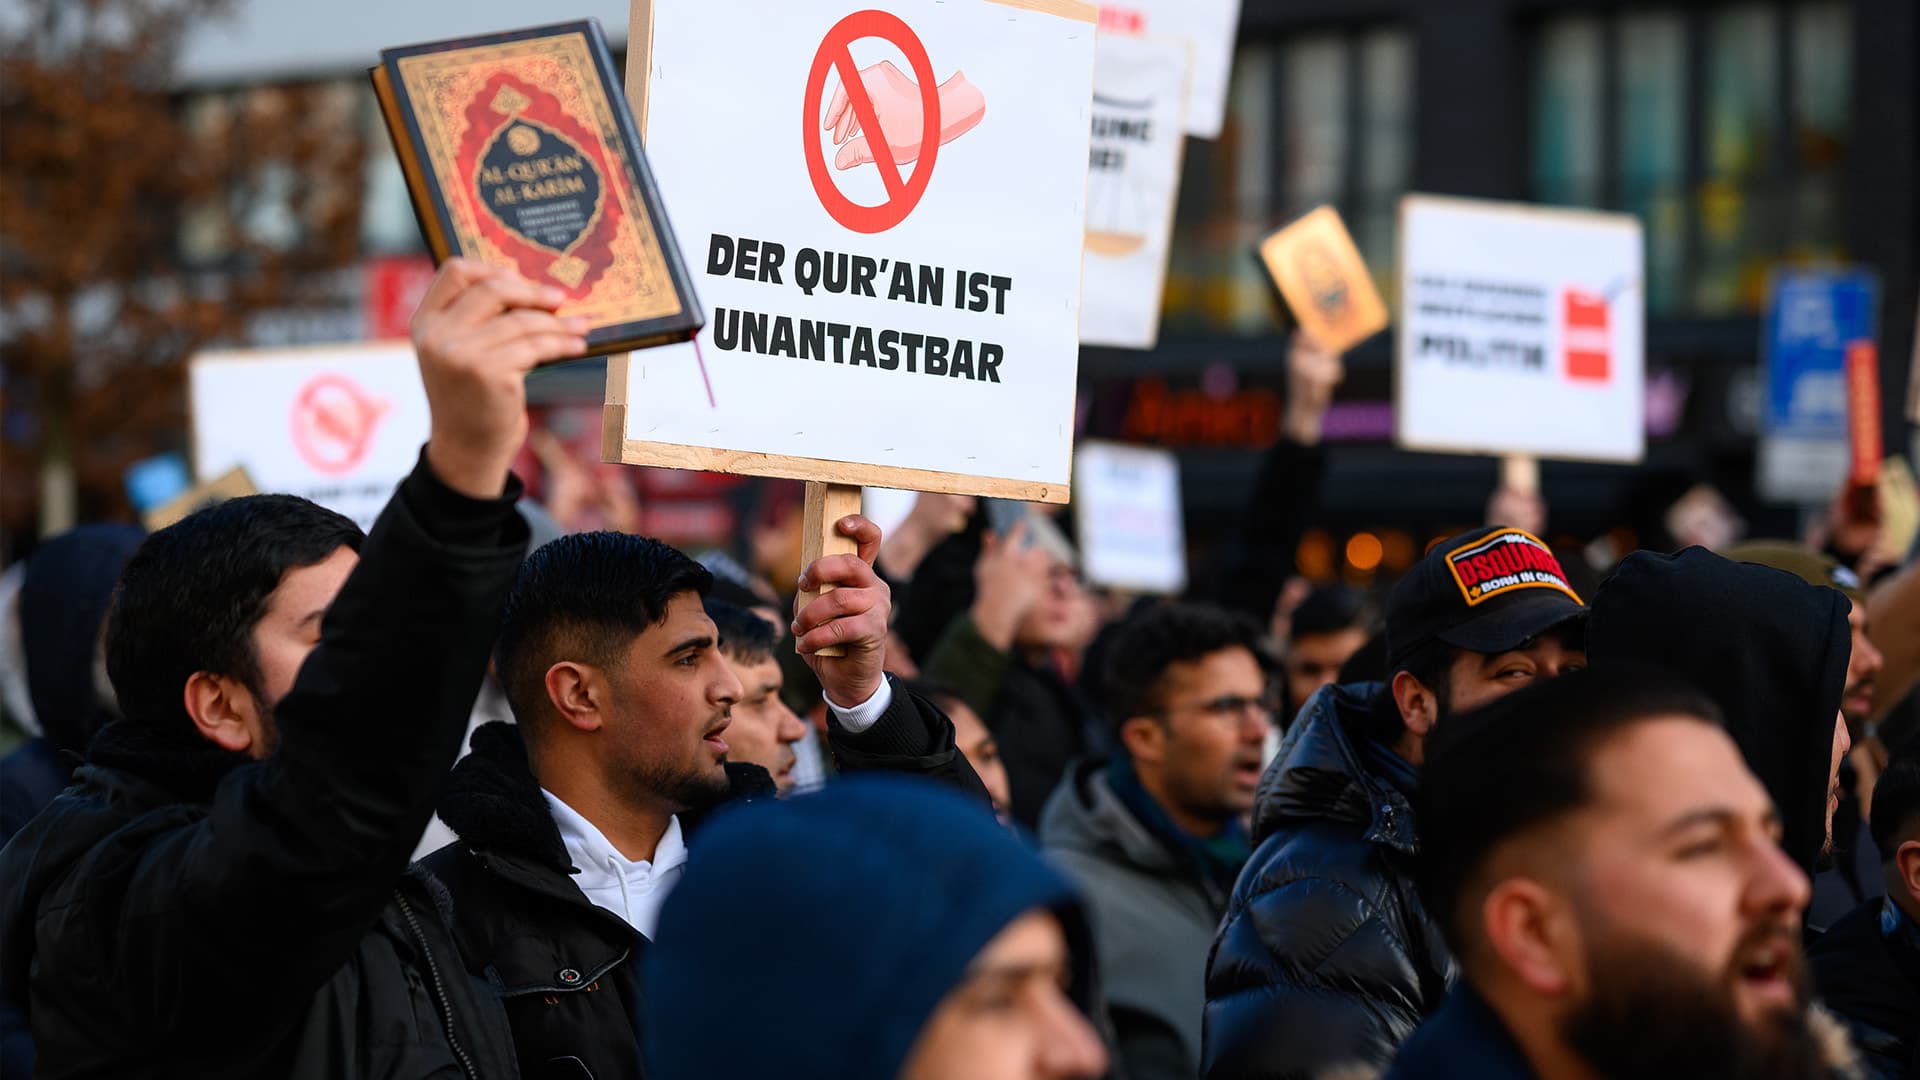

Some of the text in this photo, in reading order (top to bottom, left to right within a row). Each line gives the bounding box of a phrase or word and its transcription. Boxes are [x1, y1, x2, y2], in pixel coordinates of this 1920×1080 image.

[706, 233, 1012, 315] DER QUR'AN IST
[713, 307, 1004, 384] UNANTASTBAR
[1480, 575, 1520, 593] BORN
[1520, 571, 1536, 583] IN
